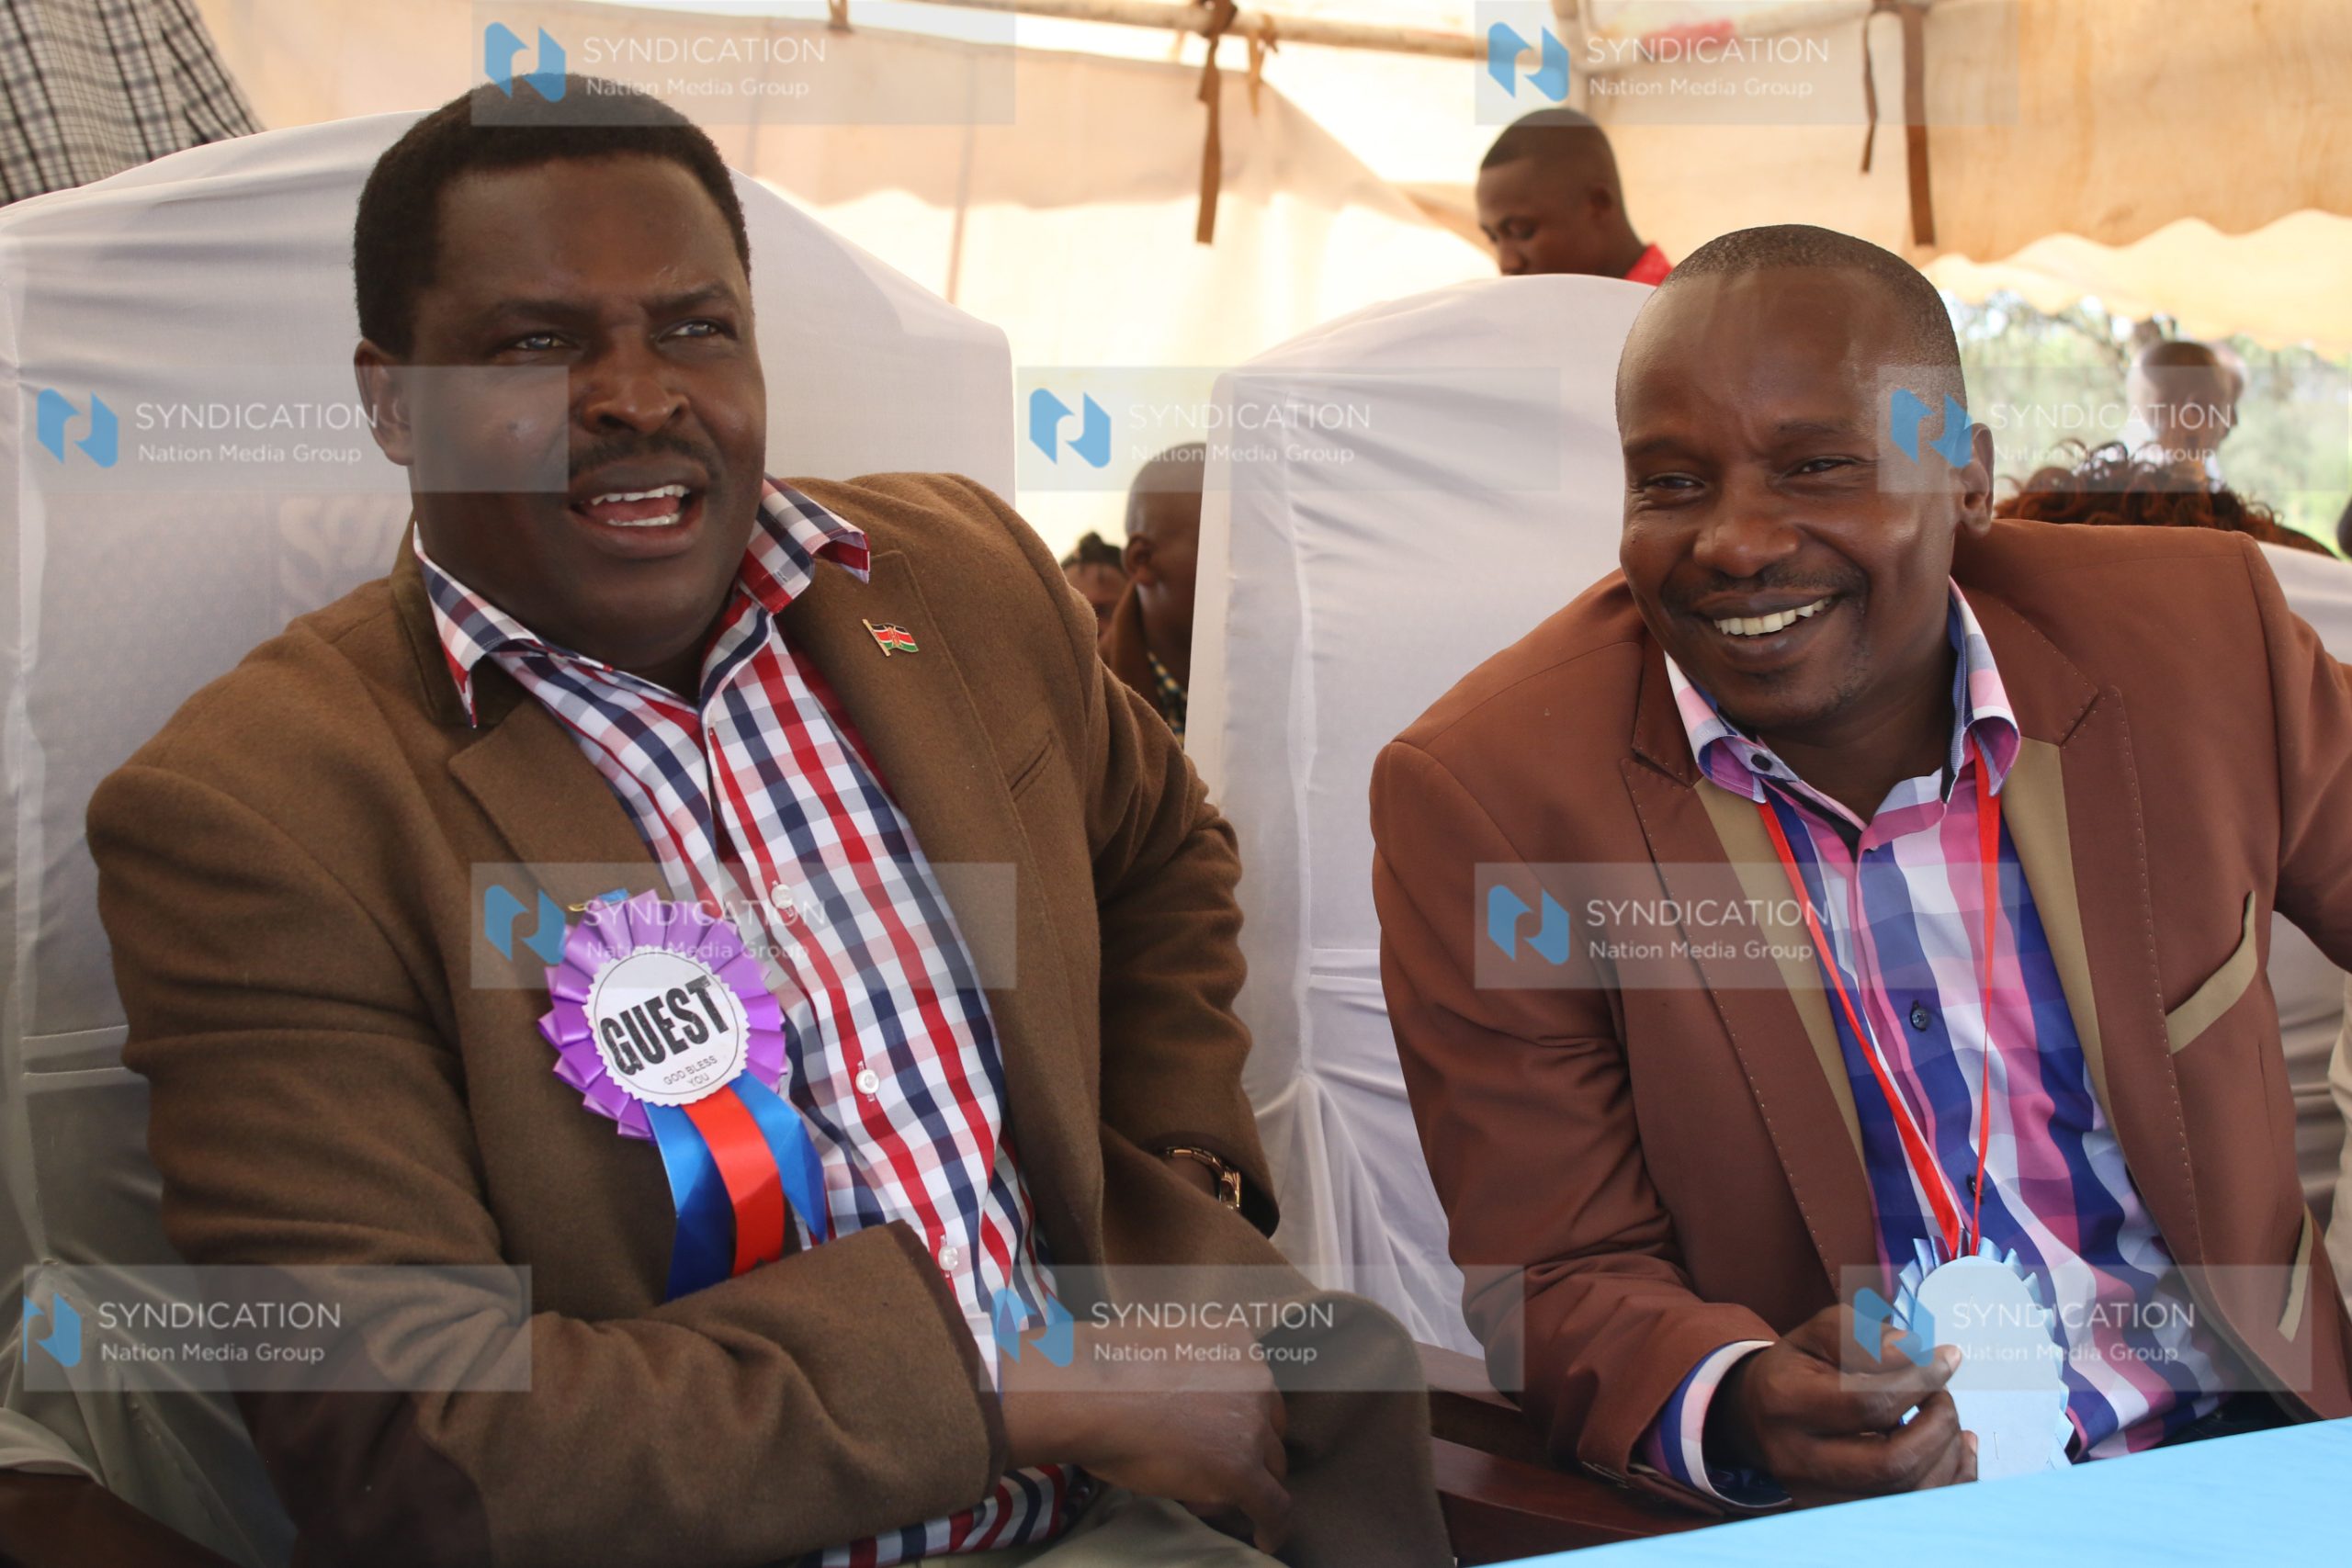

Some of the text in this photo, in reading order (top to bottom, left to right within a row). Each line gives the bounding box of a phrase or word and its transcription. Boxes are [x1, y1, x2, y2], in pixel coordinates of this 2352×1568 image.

[600, 975, 729, 1076] GUEST
[663, 1055, 718, 1085] GOD BLESS
[687, 1076, 710, 1087] YOU
